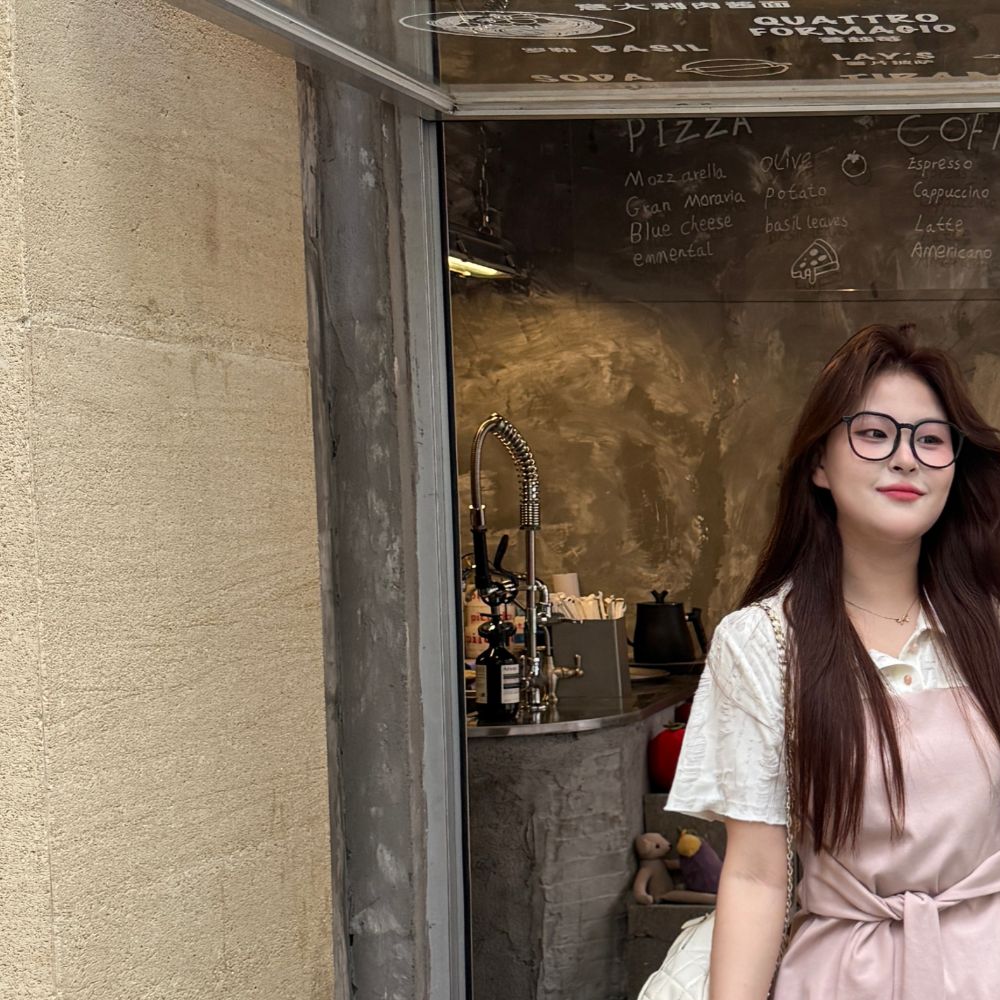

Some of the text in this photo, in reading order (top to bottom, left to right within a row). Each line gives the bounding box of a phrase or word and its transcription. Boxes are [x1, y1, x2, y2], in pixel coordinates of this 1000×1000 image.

[753, 13, 940, 26] QUATTRO
[749, 24, 957, 37] FORMAGIO
[591, 44, 710, 53] BASIL
[831, 51, 936, 61] LAY'S
[626, 117, 752, 152] PIZZA
[907, 156, 973, 176] Espresso
[913, 181, 990, 206] Cappuccino
[630, 221, 672, 244] Blue
[765, 216, 802, 233] basil
[914, 214, 964, 233] Latte
[911, 241, 992, 260] Americano
